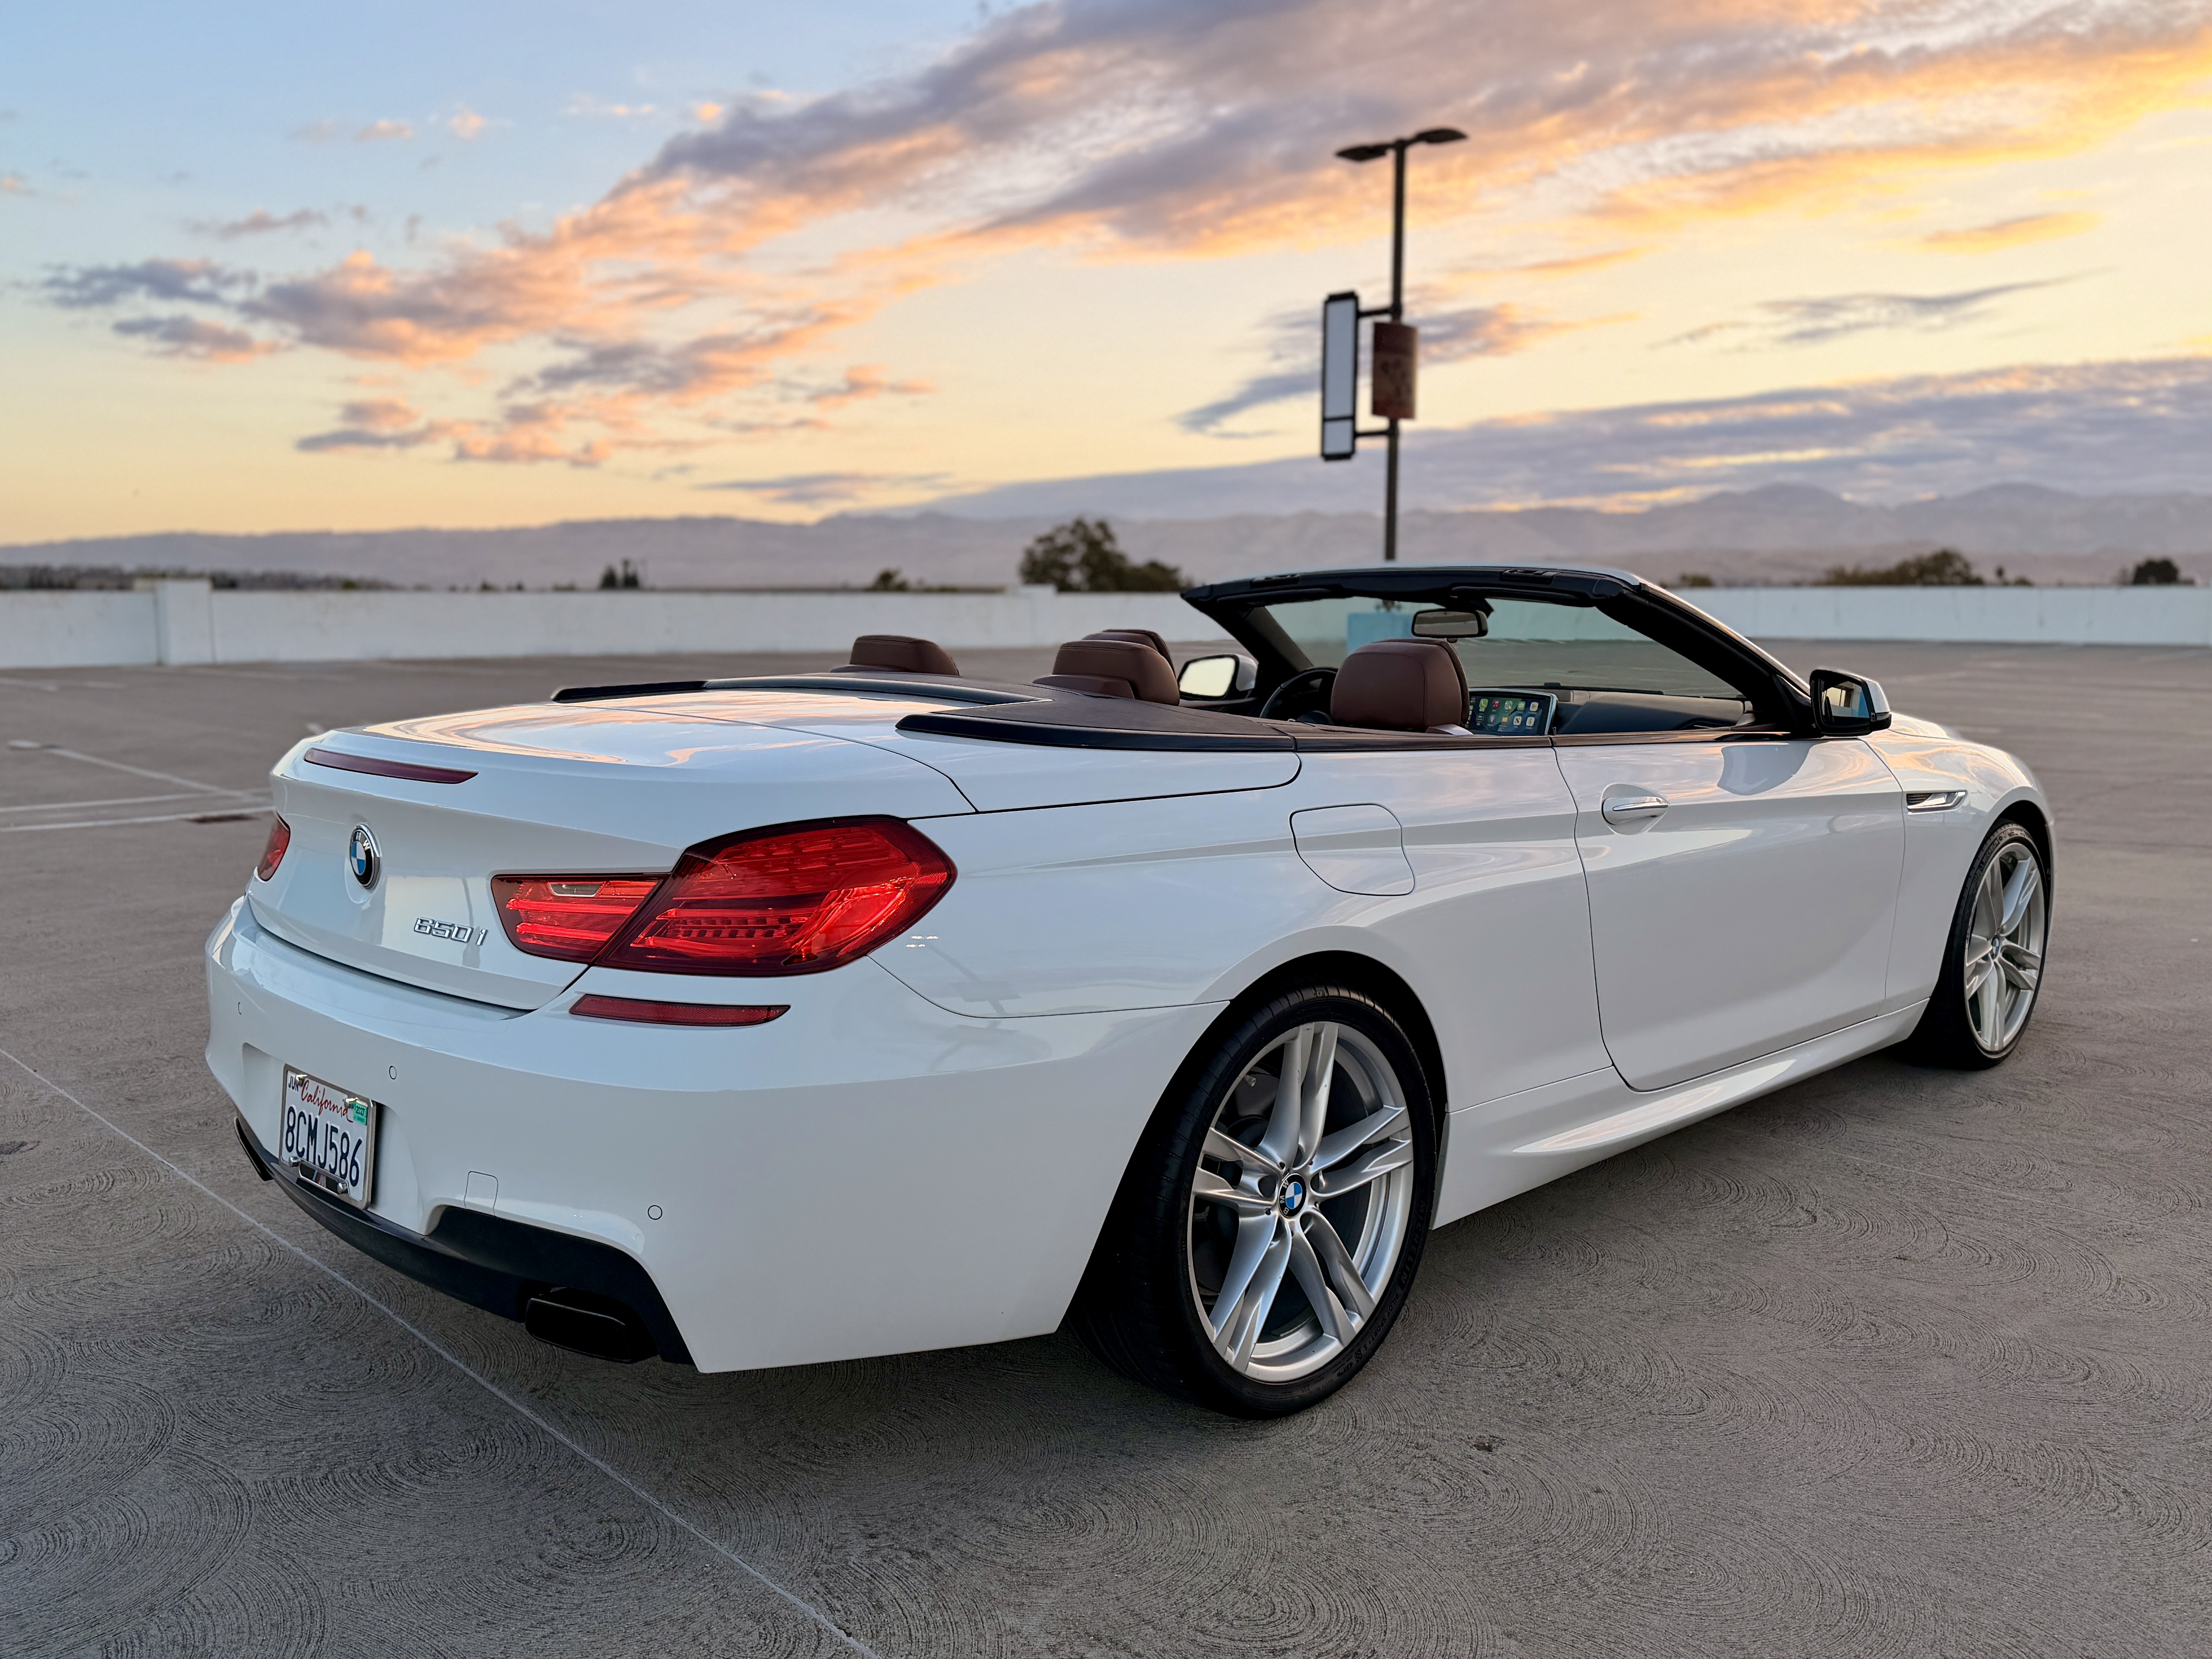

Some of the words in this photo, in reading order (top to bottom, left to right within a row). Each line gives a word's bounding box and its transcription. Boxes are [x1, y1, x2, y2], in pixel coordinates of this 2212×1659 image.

[352, 832, 370, 850] MW
[301, 1079, 353, 1123] California
[286, 1106, 362, 1187] 8CMJ586
[1279, 1179, 1289, 1215] BMW
[1400, 1200, 1425, 1284] MICHELIN
[1387, 1293, 1399, 1318] PILOT
[1371, 1316, 1386, 1342] SPORT
